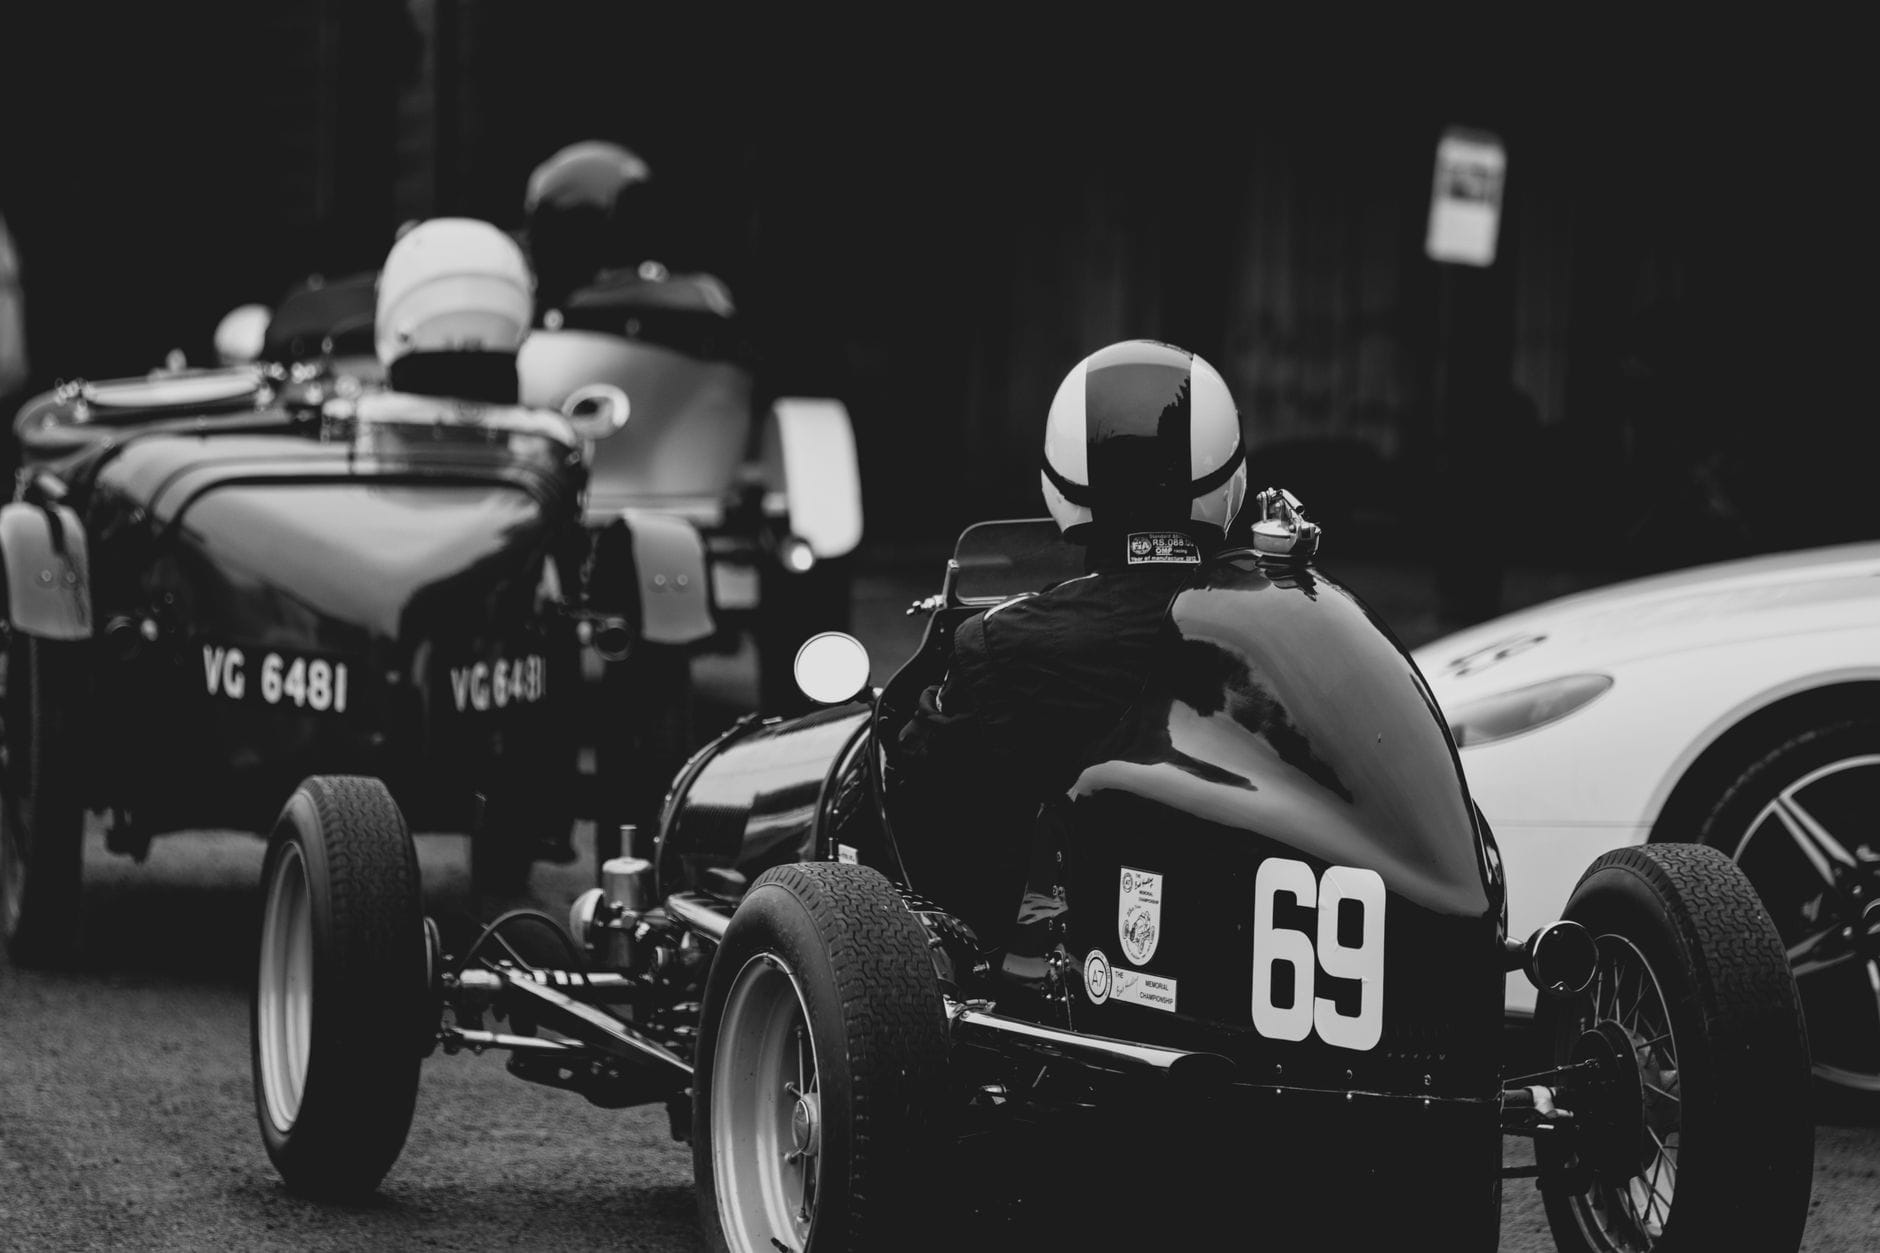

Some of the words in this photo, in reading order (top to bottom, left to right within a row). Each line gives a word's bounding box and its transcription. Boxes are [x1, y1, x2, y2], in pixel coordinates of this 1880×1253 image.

[203, 644, 245, 699] VG
[262, 652, 348, 713] 6481
[450, 660, 490, 712] VG
[1252, 857, 1386, 1051] 69
[1091, 969, 1104, 987] A7
[1115, 970, 1123, 979] THE
[1145, 980, 1168, 991] MEMORIAL
[1140, 991, 1174, 1004] CHAMPIONSHIP
